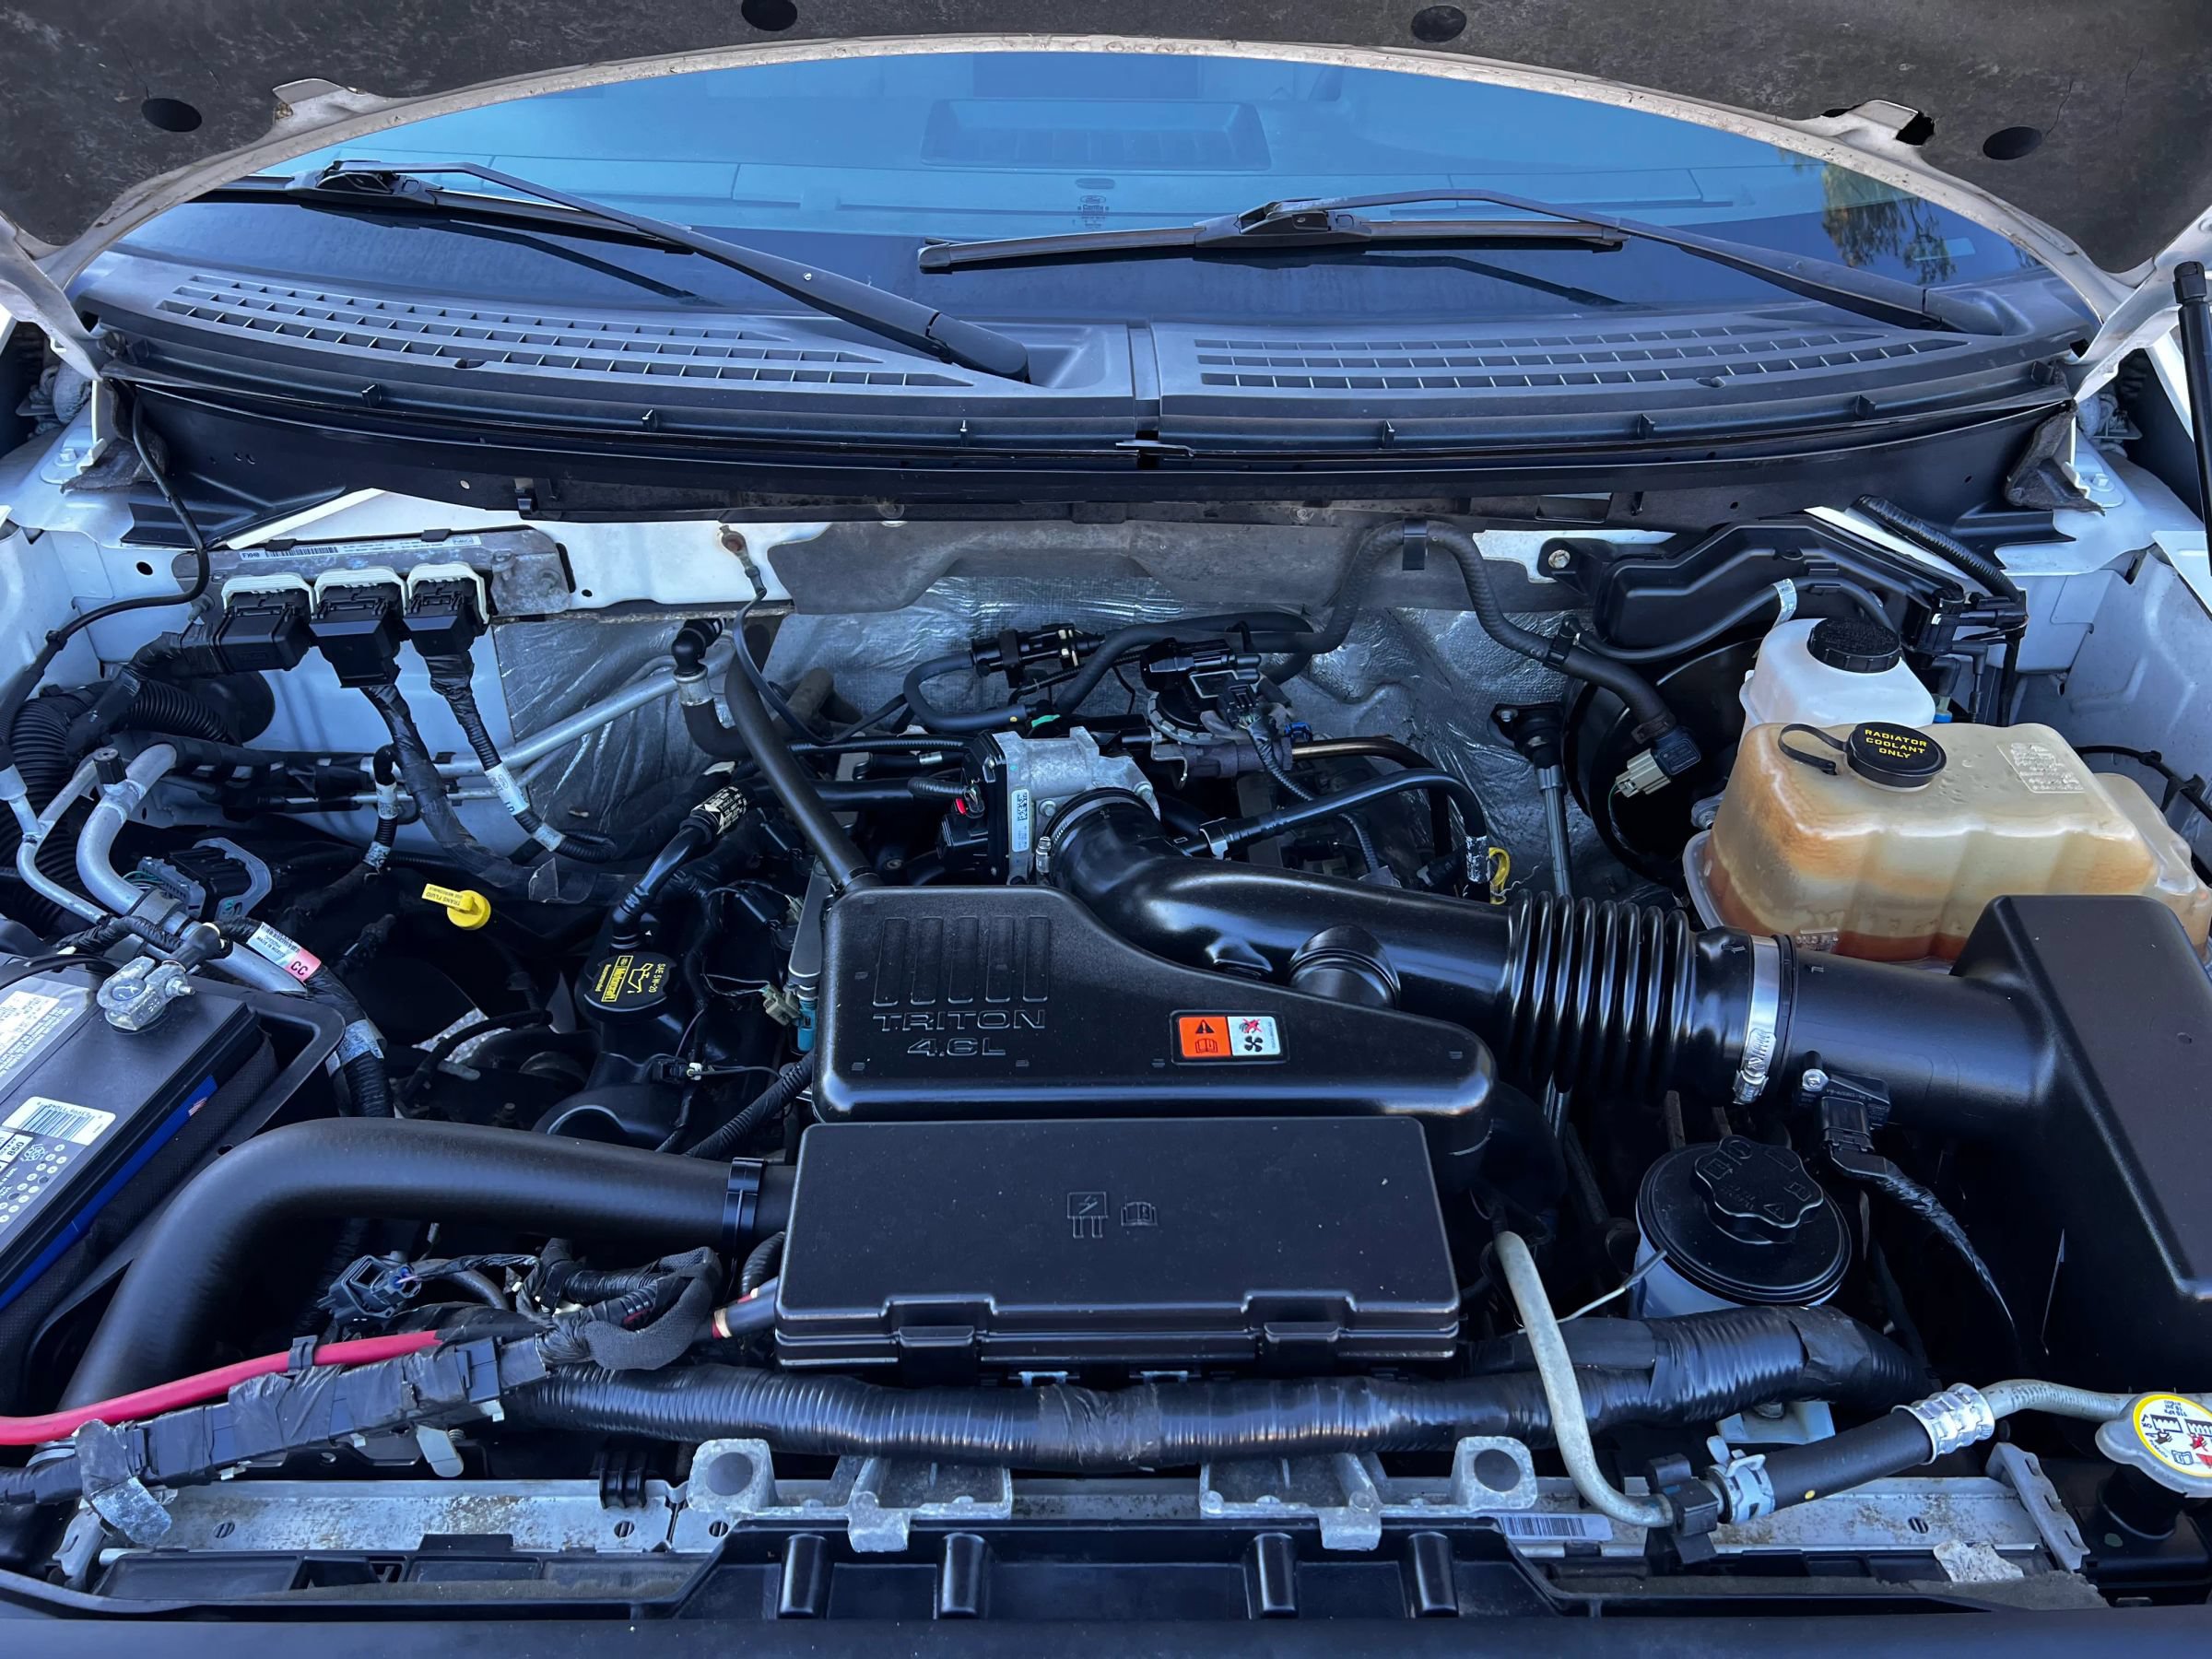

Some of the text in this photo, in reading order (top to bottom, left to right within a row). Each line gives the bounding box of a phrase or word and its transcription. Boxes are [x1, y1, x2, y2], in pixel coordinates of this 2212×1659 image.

[1865, 729, 1927, 747] RADIATOR
[1865, 737, 1925, 754] COOLANT
[1878, 747, 1911, 759] ONLY
[426, 892, 461, 906] TRANS FLUID
[290, 960, 309, 976] CC
[604, 968, 627, 1000] Motorcraft
[648, 963, 665, 993] SAE 5W-20
[872, 1009, 1046, 1031] TRITON
[907, 1037, 1006, 1057] 4.6L
[7, 1141, 25, 1157] 850
